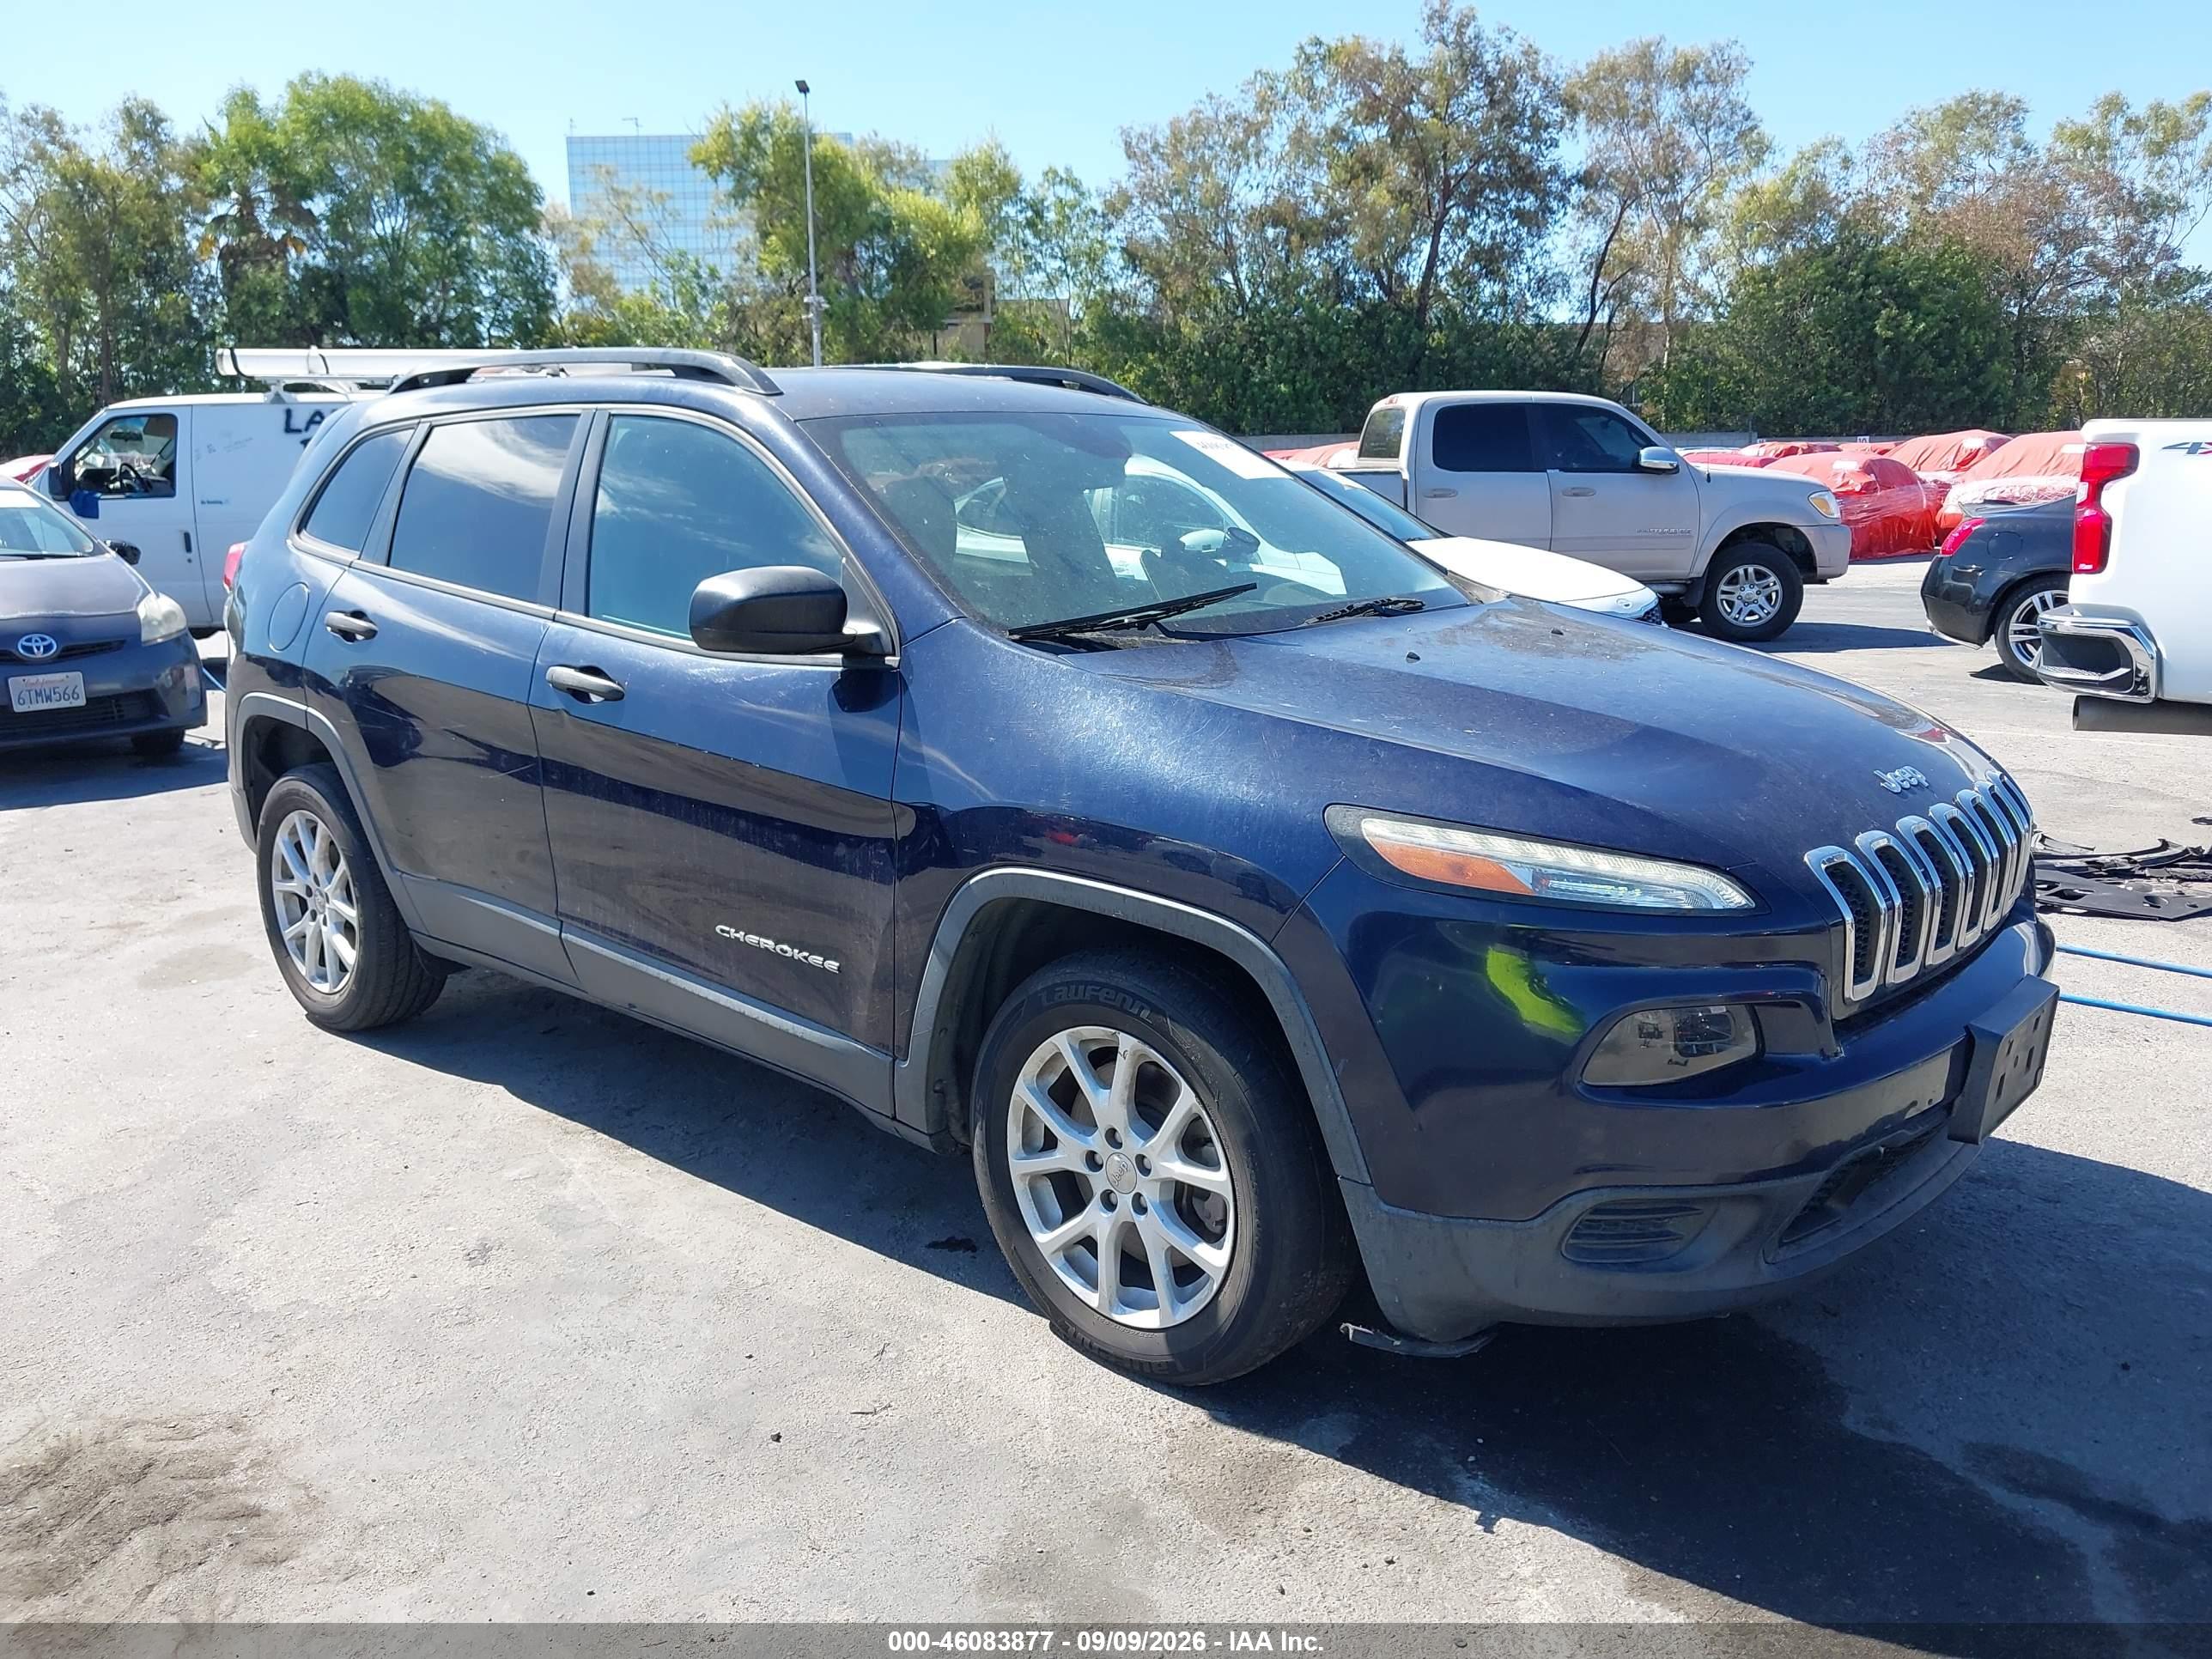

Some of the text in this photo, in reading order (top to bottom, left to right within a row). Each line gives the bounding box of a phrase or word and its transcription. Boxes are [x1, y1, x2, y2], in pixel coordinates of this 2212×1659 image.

[284, 408, 338, 434] LA
[18, 685, 79, 706] 6TMW566
[1873, 765, 1929, 793] Jeep
[715, 925, 841, 974] CHEROKEE
[1112, 1161, 1128, 1187] Jeep
